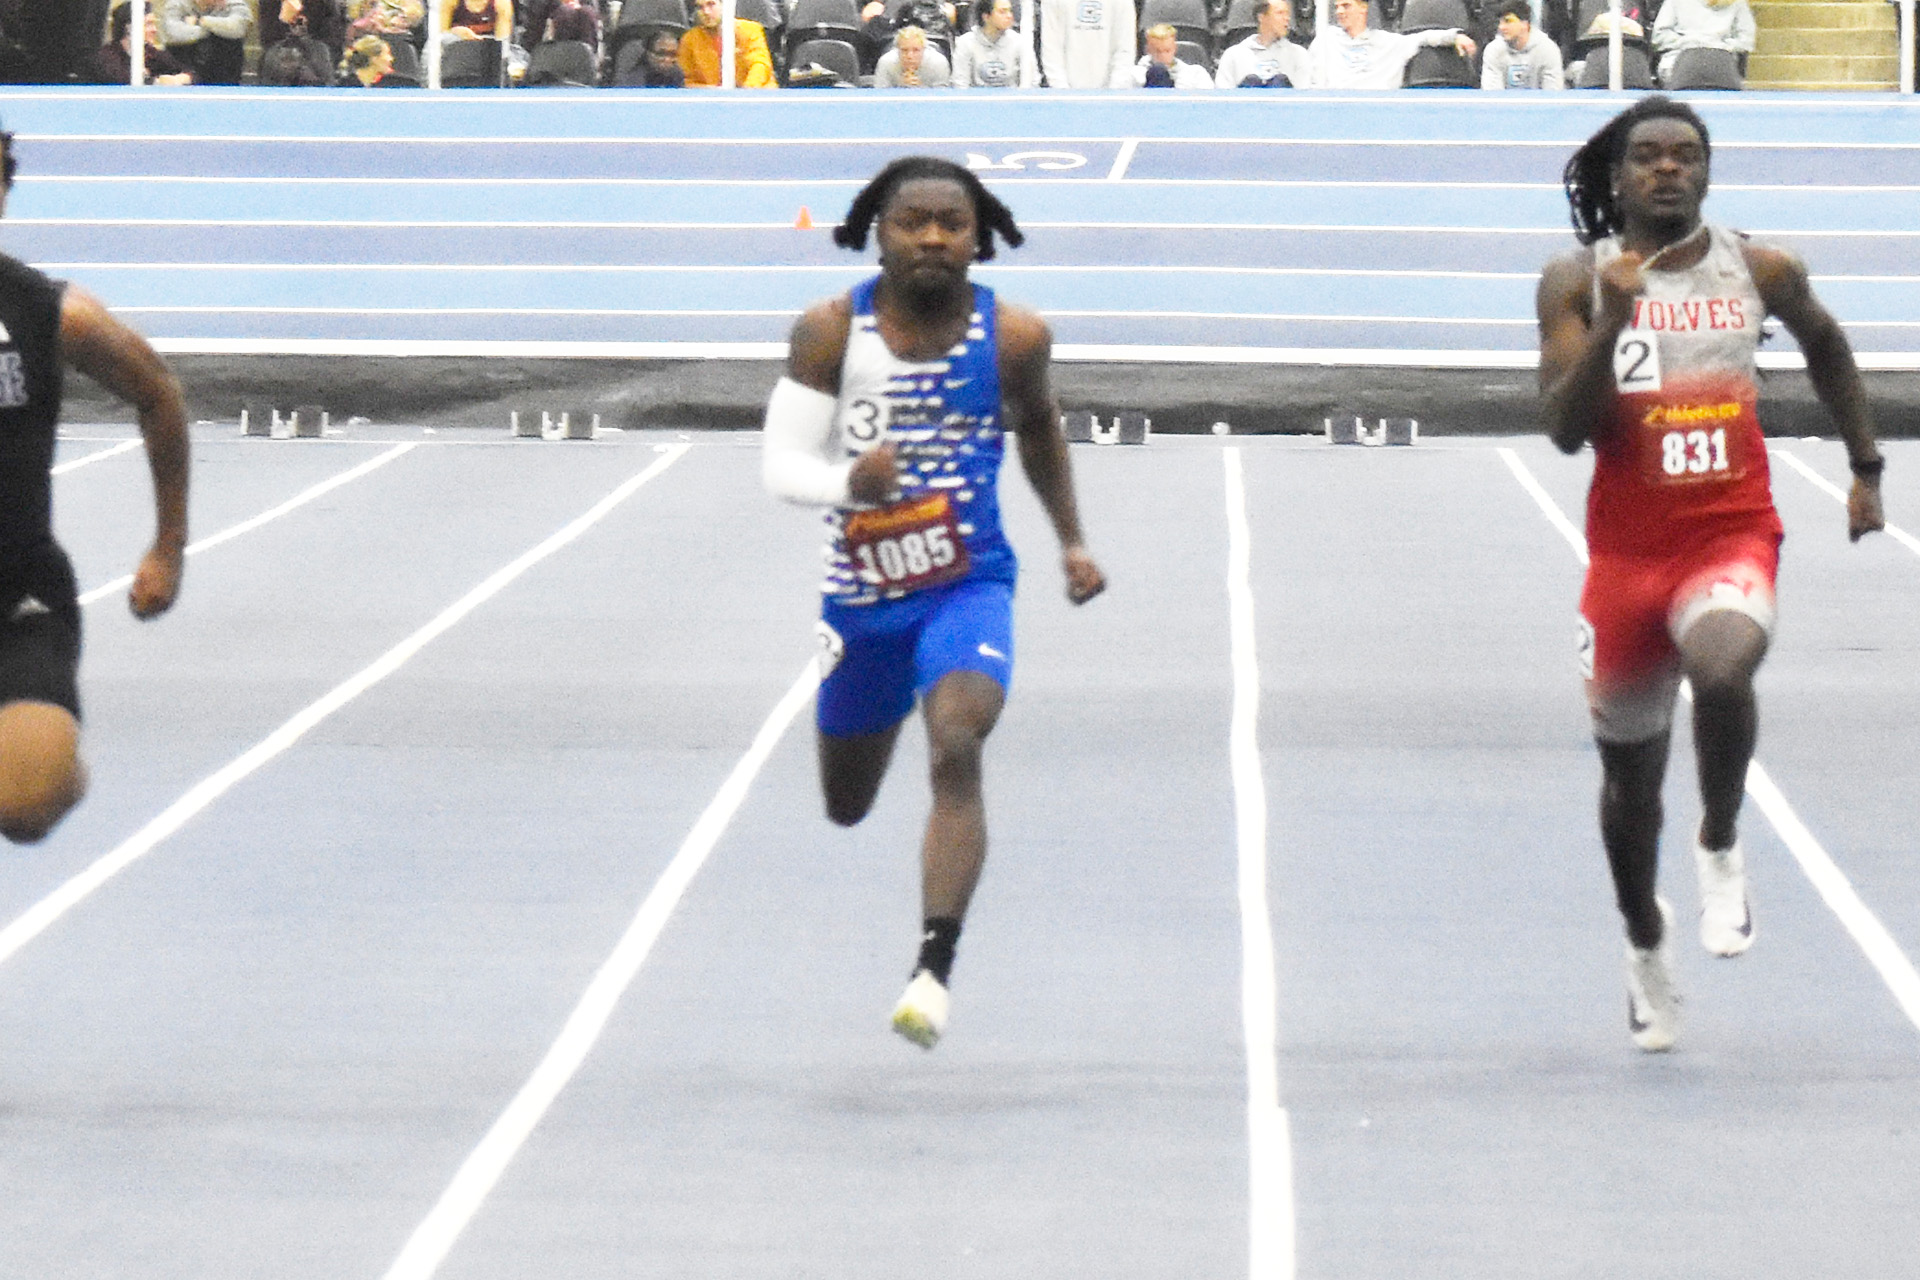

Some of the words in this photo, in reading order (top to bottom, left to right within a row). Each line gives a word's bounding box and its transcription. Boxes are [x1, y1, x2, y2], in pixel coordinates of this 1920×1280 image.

[1620, 340, 1654, 383] 2
[848, 400, 878, 440] 3
[1662, 428, 1729, 475] 831
[858, 525, 956, 585] 1085
